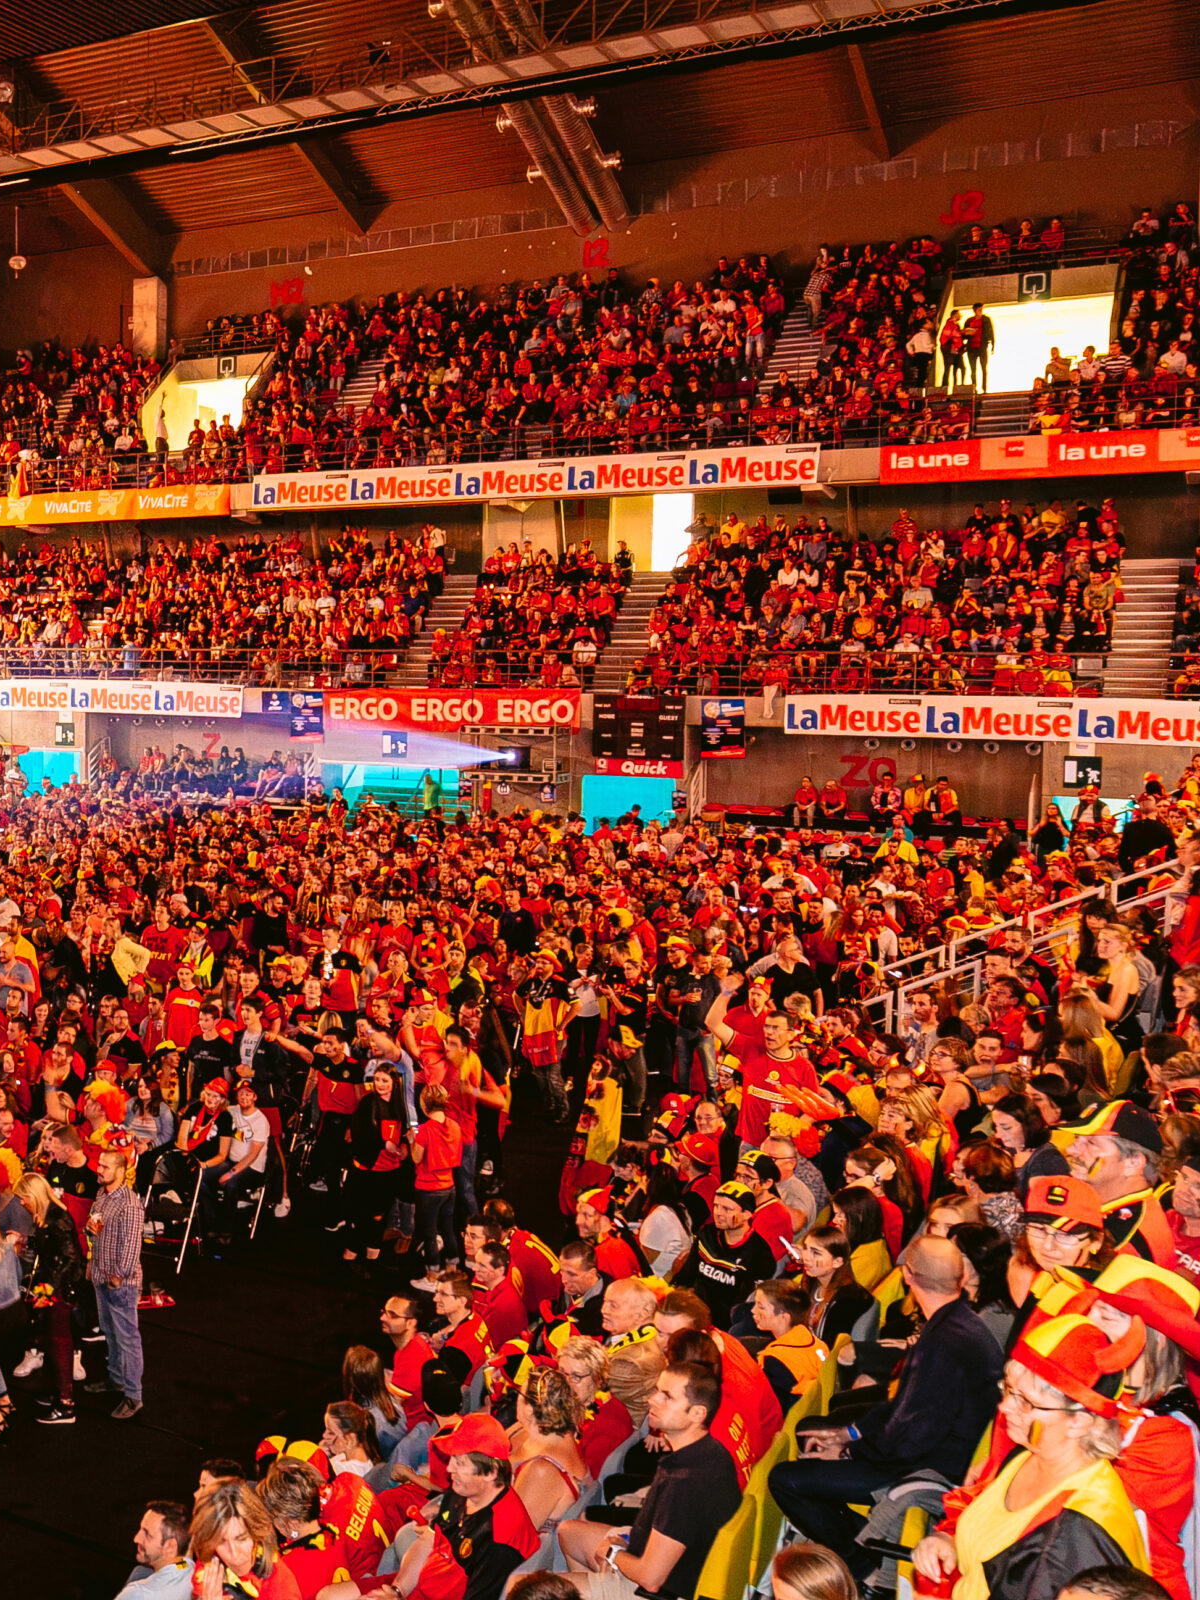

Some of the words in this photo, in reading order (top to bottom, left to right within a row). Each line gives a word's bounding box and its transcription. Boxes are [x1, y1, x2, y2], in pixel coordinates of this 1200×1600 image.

[271, 278, 304, 306] H2
[891, 453, 913, 469] la
[918, 452, 970, 468] une
[1059, 443, 1085, 461] la
[1089, 443, 1146, 459] une
[329, 697, 398, 721] ERGO
[411, 698, 484, 722] ERGO
[497, 699, 574, 723] ERGO
[1077, 709, 1200, 742] LaMeu
[620, 760, 668, 775] Quick
[330, 1081, 338, 1093] 7
[388, 1125, 395, 1138] 7
